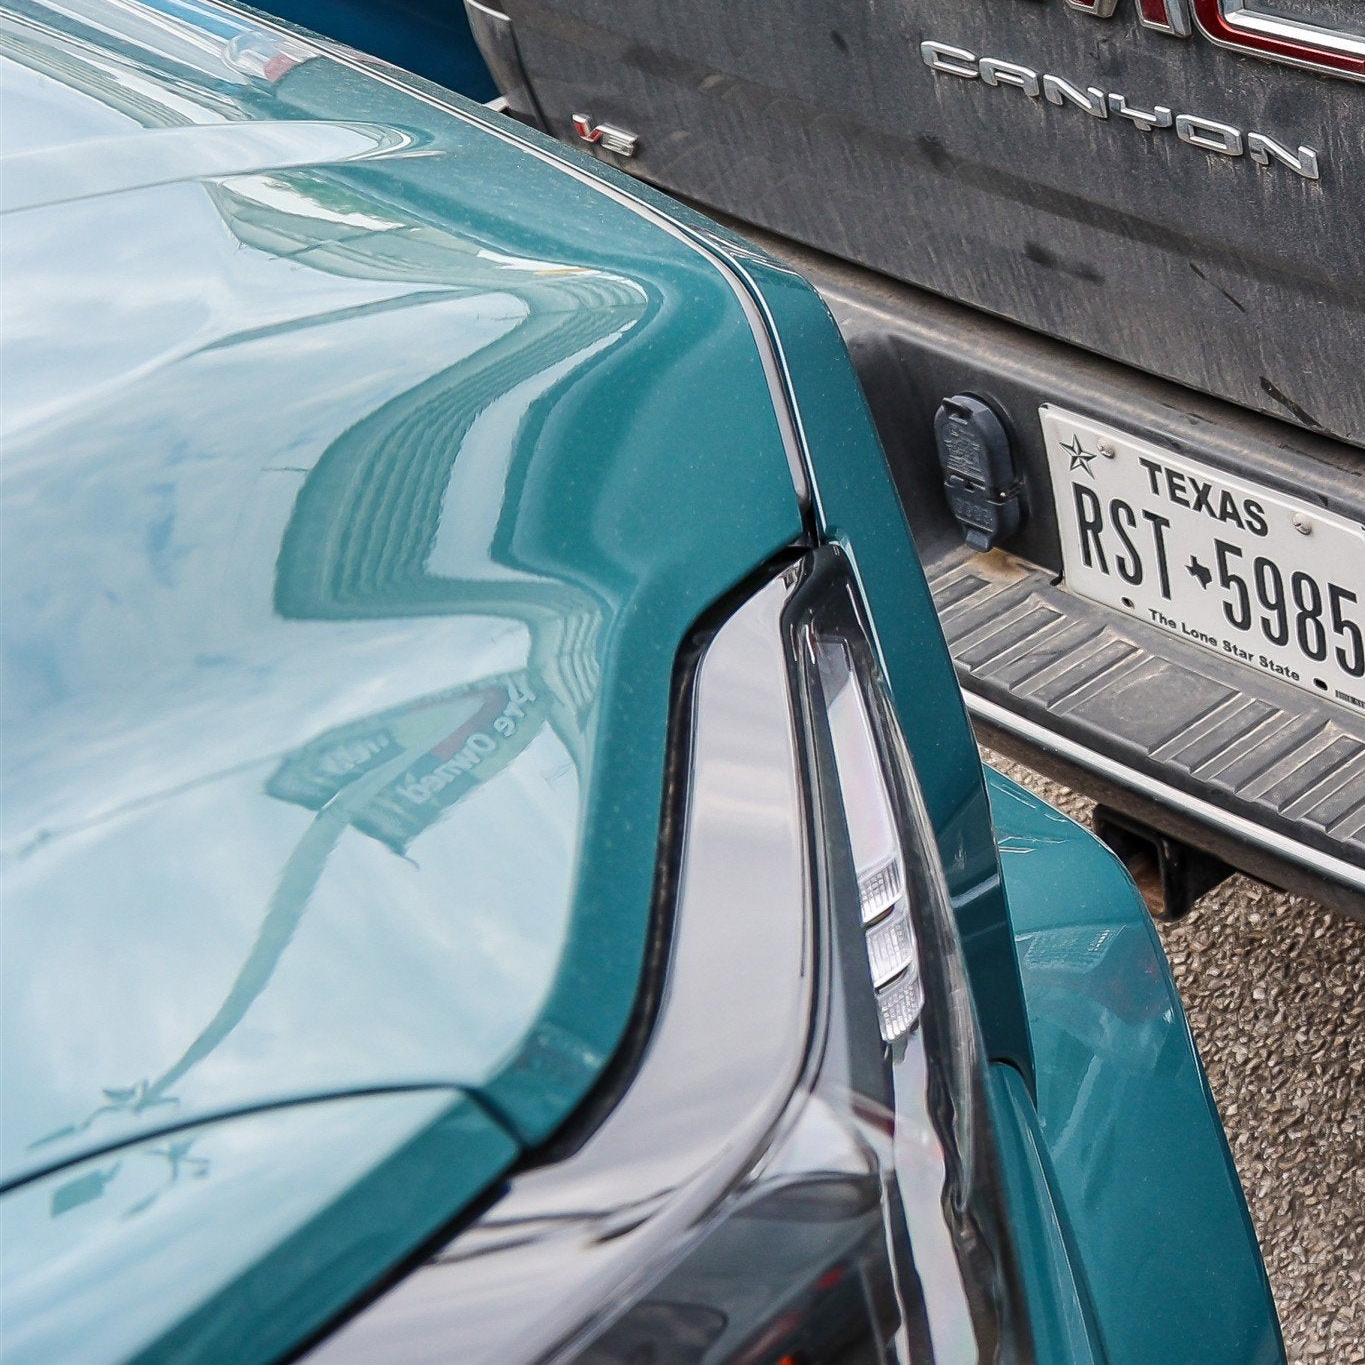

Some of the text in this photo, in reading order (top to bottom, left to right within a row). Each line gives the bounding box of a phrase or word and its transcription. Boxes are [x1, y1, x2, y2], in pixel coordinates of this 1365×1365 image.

[920, 39, 1320, 180] CANYON
[1138, 456, 1269, 537] TEXAS
[1072, 481, 1365, 678] RST 5985
[1148, 607, 1301, 682] The Lone Star State
